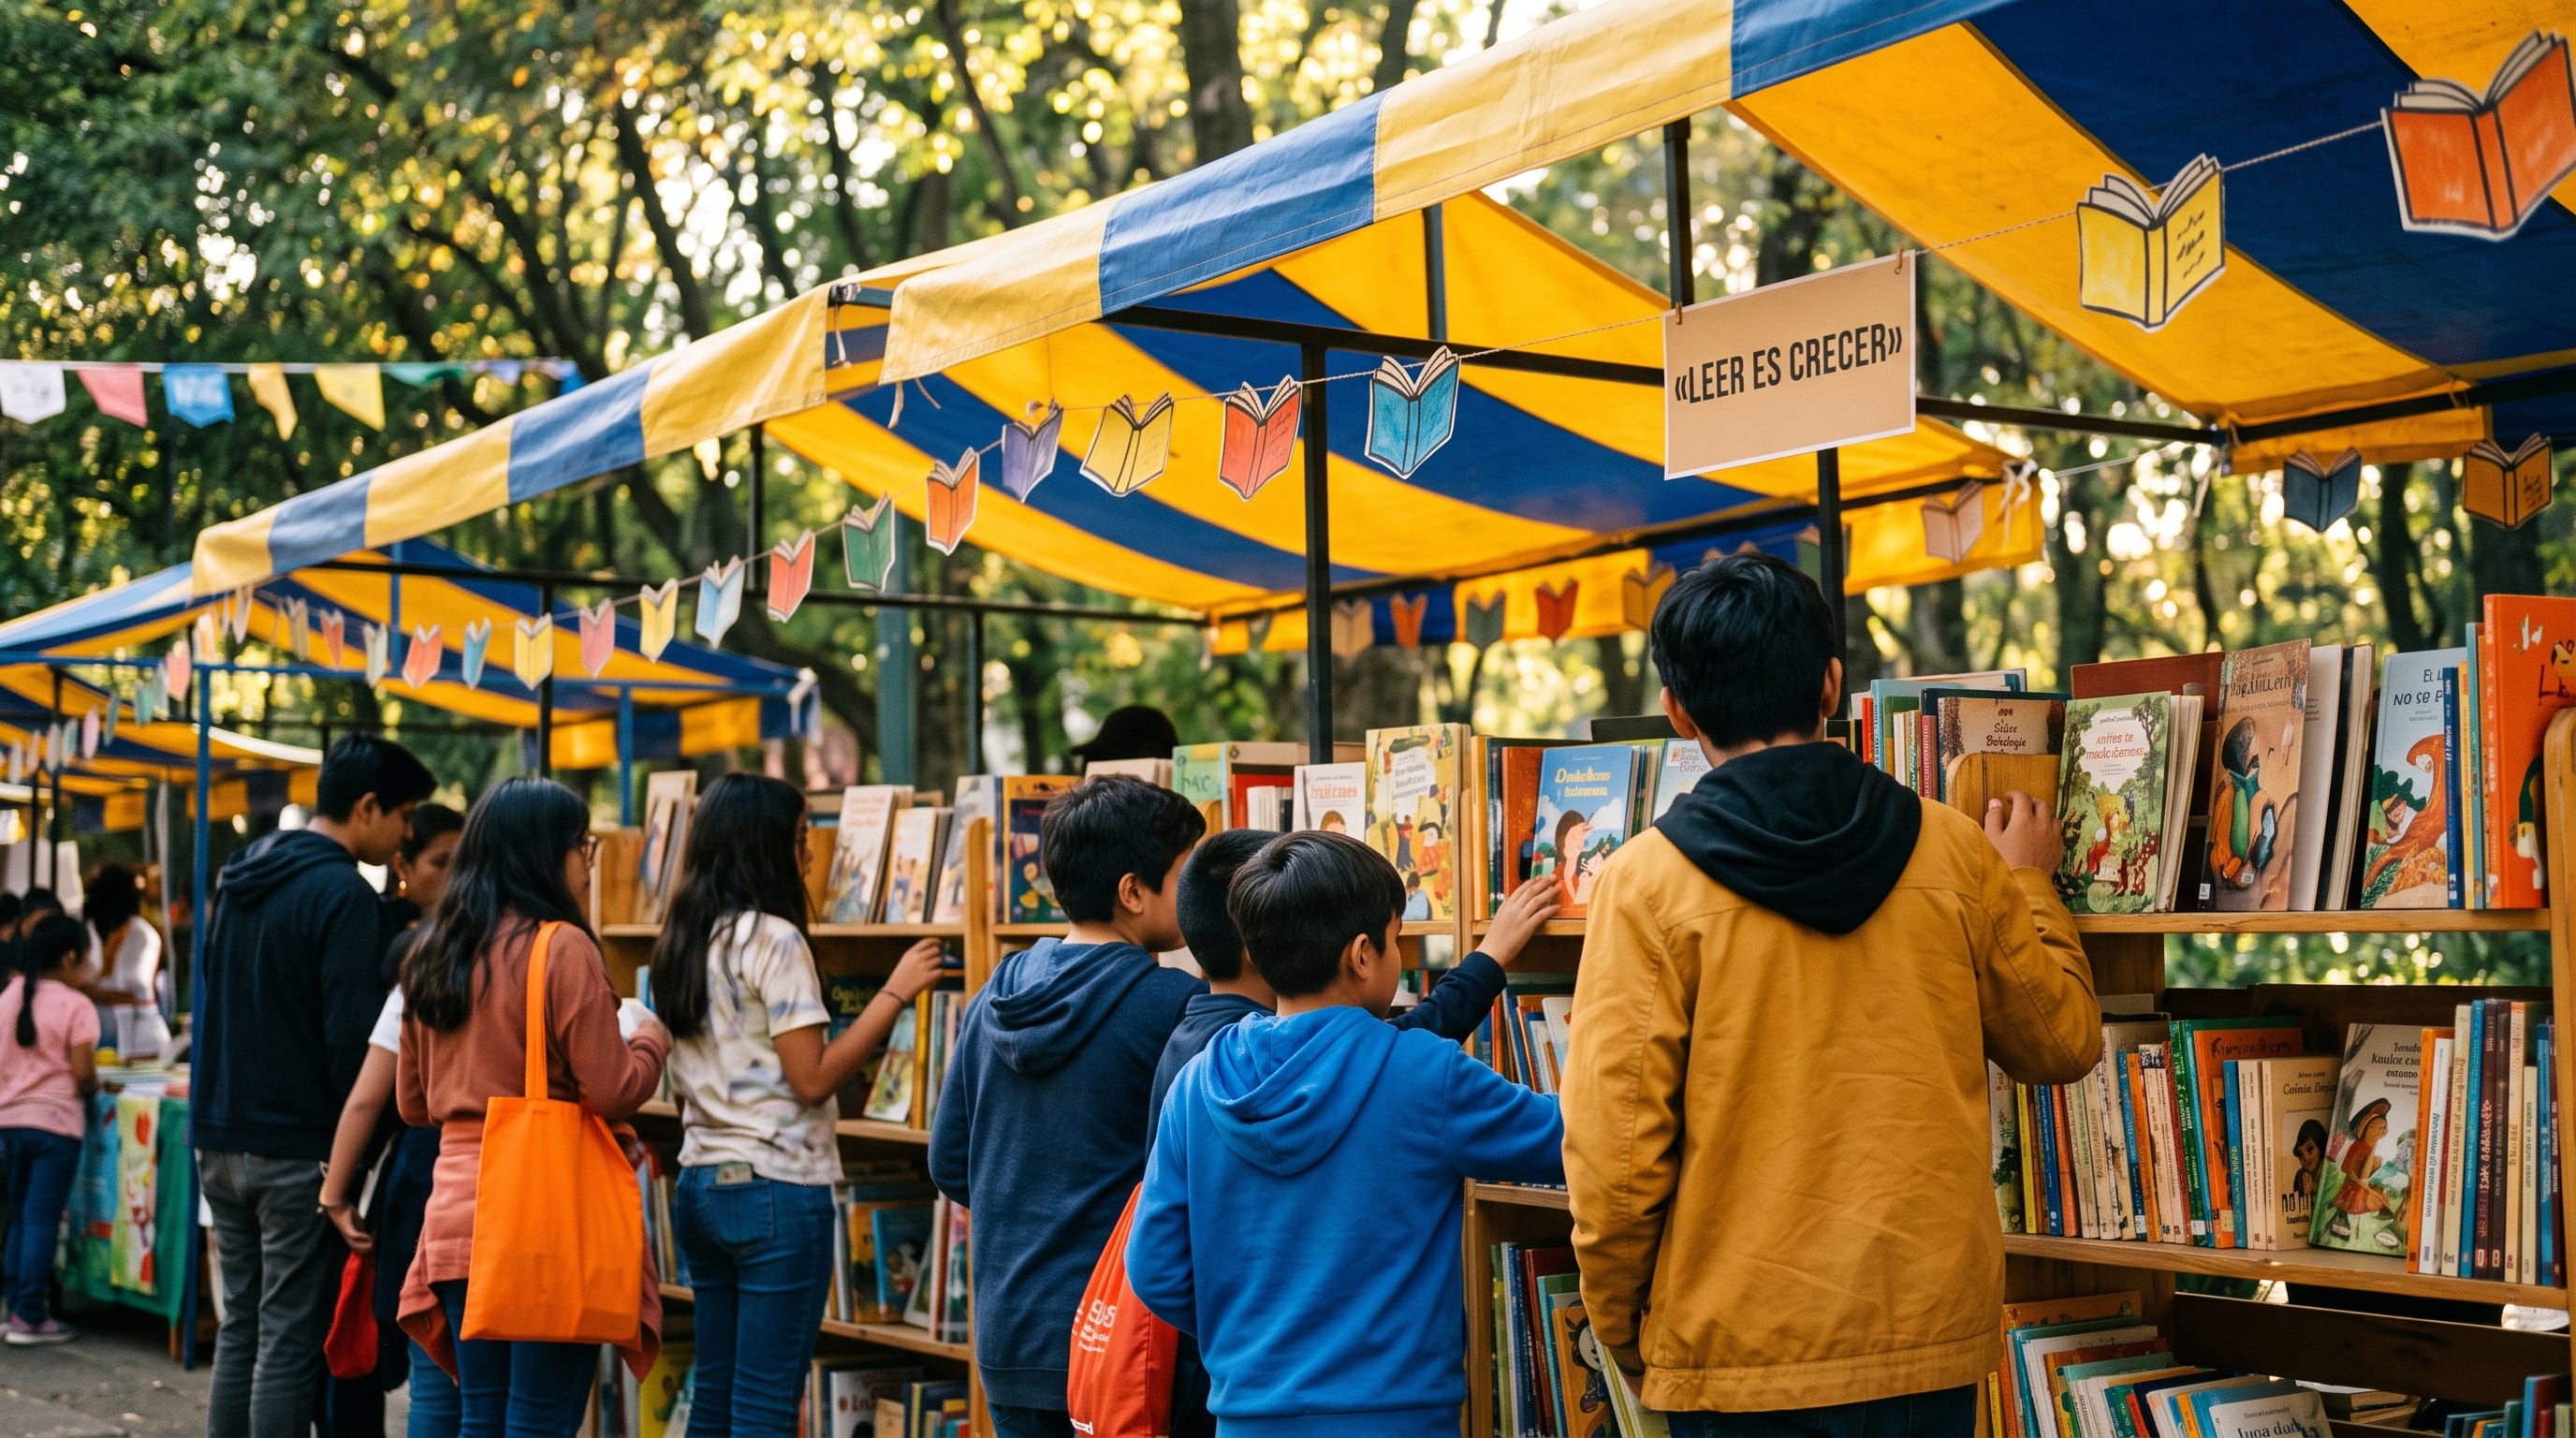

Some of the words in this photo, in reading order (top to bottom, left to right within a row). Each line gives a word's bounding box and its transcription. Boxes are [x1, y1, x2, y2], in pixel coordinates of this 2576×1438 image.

[1675, 355, 1745, 404] «LEER
[1752, 346, 1781, 390] ES
[1789, 323, 1903, 382] CRECER»
